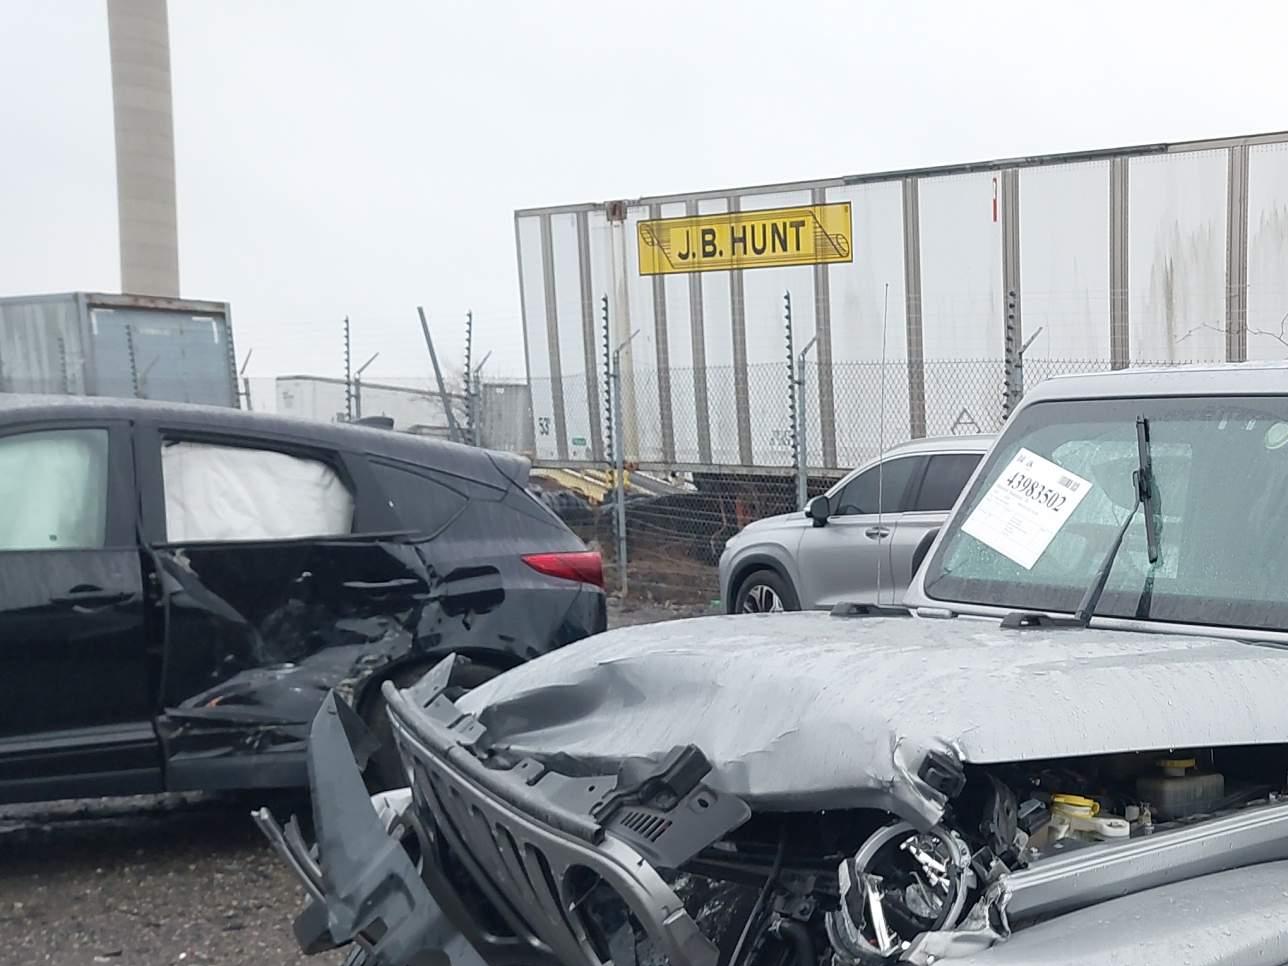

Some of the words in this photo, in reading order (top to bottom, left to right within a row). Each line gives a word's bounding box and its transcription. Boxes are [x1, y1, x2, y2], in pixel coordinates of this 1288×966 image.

[678, 228, 723, 261] J.B.
[731, 219, 806, 257] HUNT
[1006, 471, 1067, 512] 43983502
